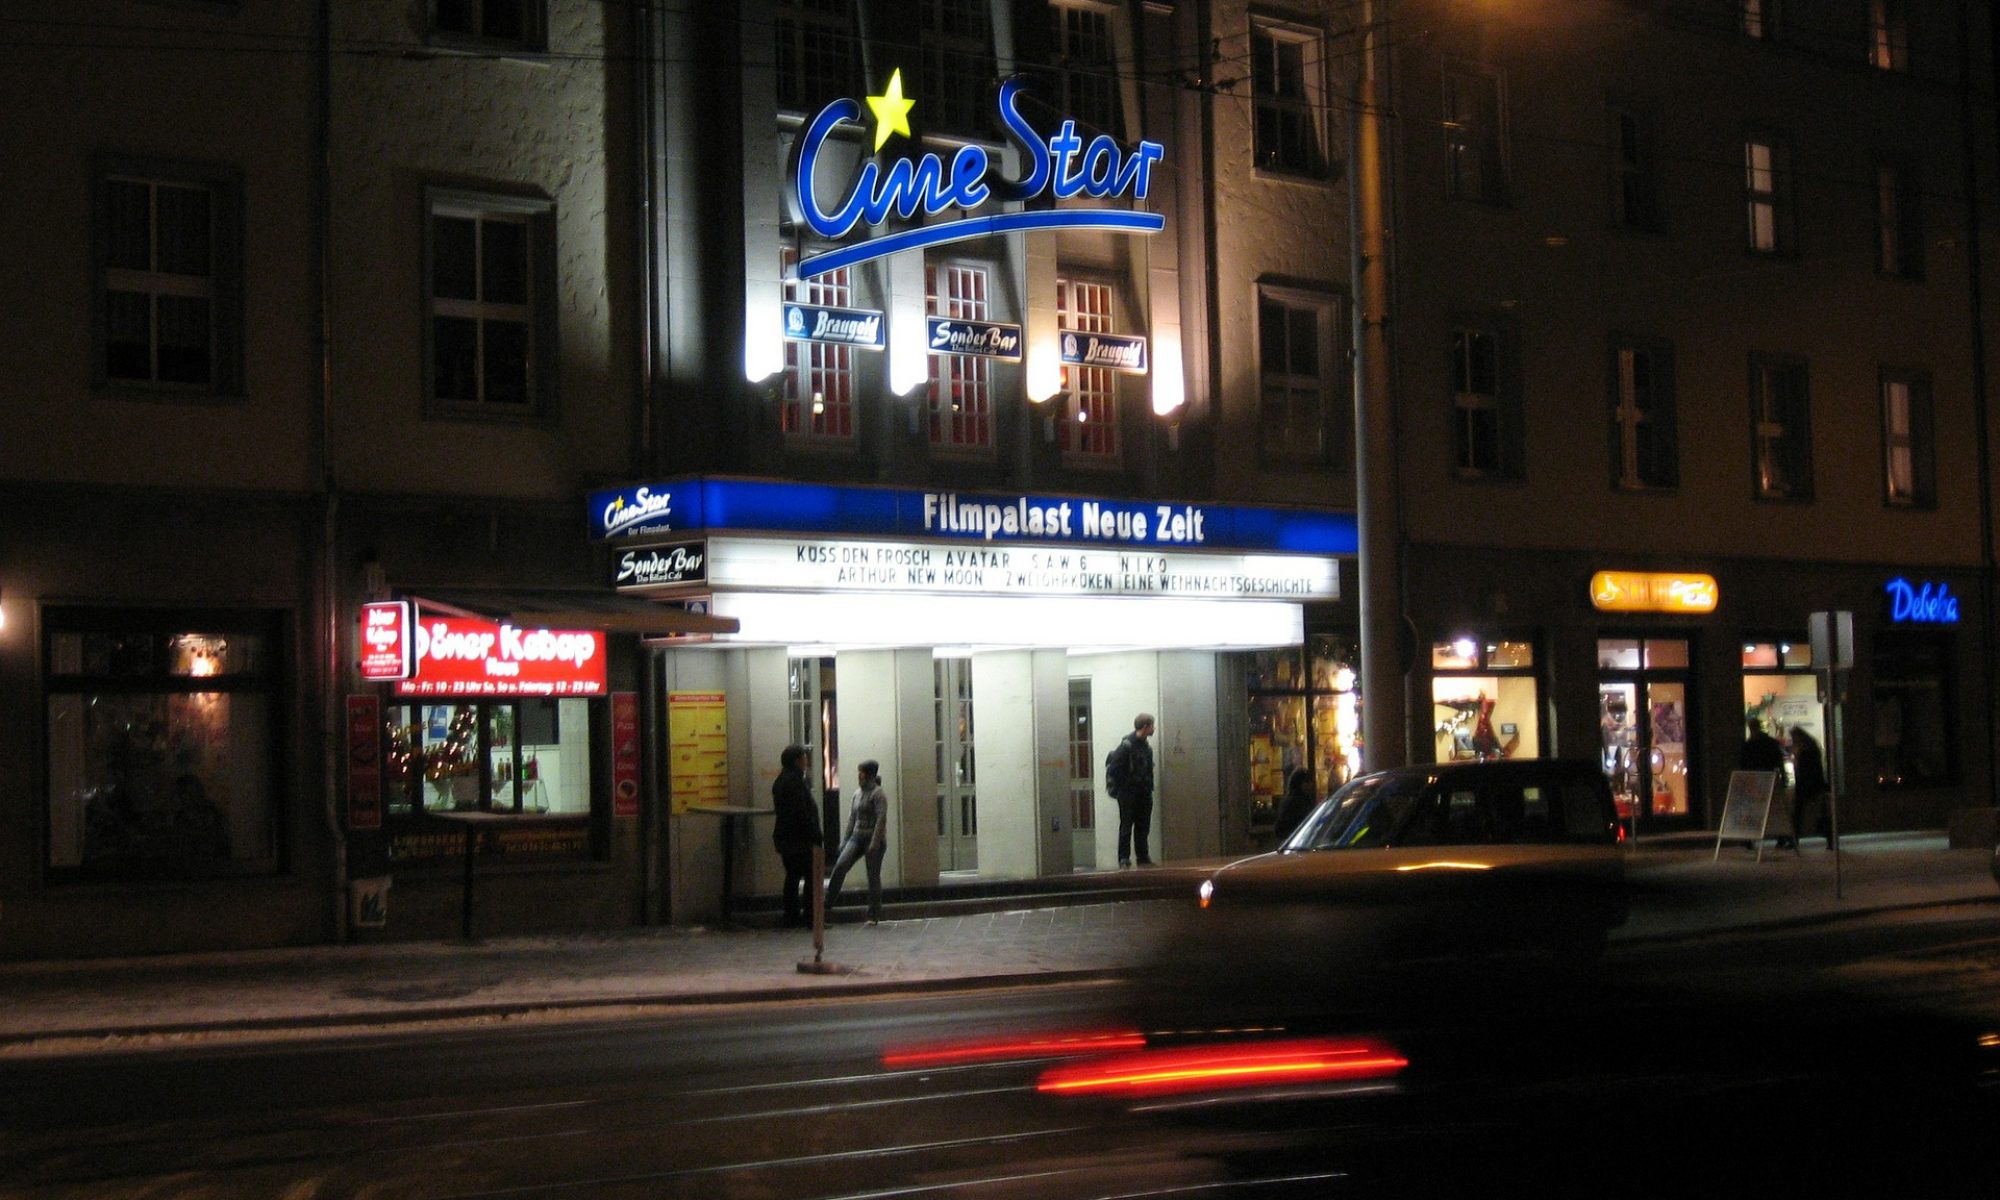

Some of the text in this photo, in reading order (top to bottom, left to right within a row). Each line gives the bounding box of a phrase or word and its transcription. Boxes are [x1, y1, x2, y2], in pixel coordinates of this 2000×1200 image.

[812, 311, 879, 341] Braugold
[986, 327, 1017, 351] Bar
[1085, 337, 1142, 366] Braugold
[924, 493, 1205, 543] Filmpalast Neue Zeit
[617, 547, 703, 581] Sonder Bar
[842, 547, 868, 564] DEN
[877, 549, 930, 566] FROSCH
[945, 550, 1010, 568] AVATAR
[1121, 557, 1167, 573] NIKO
[838, 566, 896, 583] ARTHUR
[908, 568, 936, 584] NEW
[944, 569, 982, 585] MOON
[1124, 574, 1154, 590] EINE
[1160, 575, 1312, 593] WEIHNACHTSGESCHICHTE
[1886, 578, 1957, 620] Debeka
